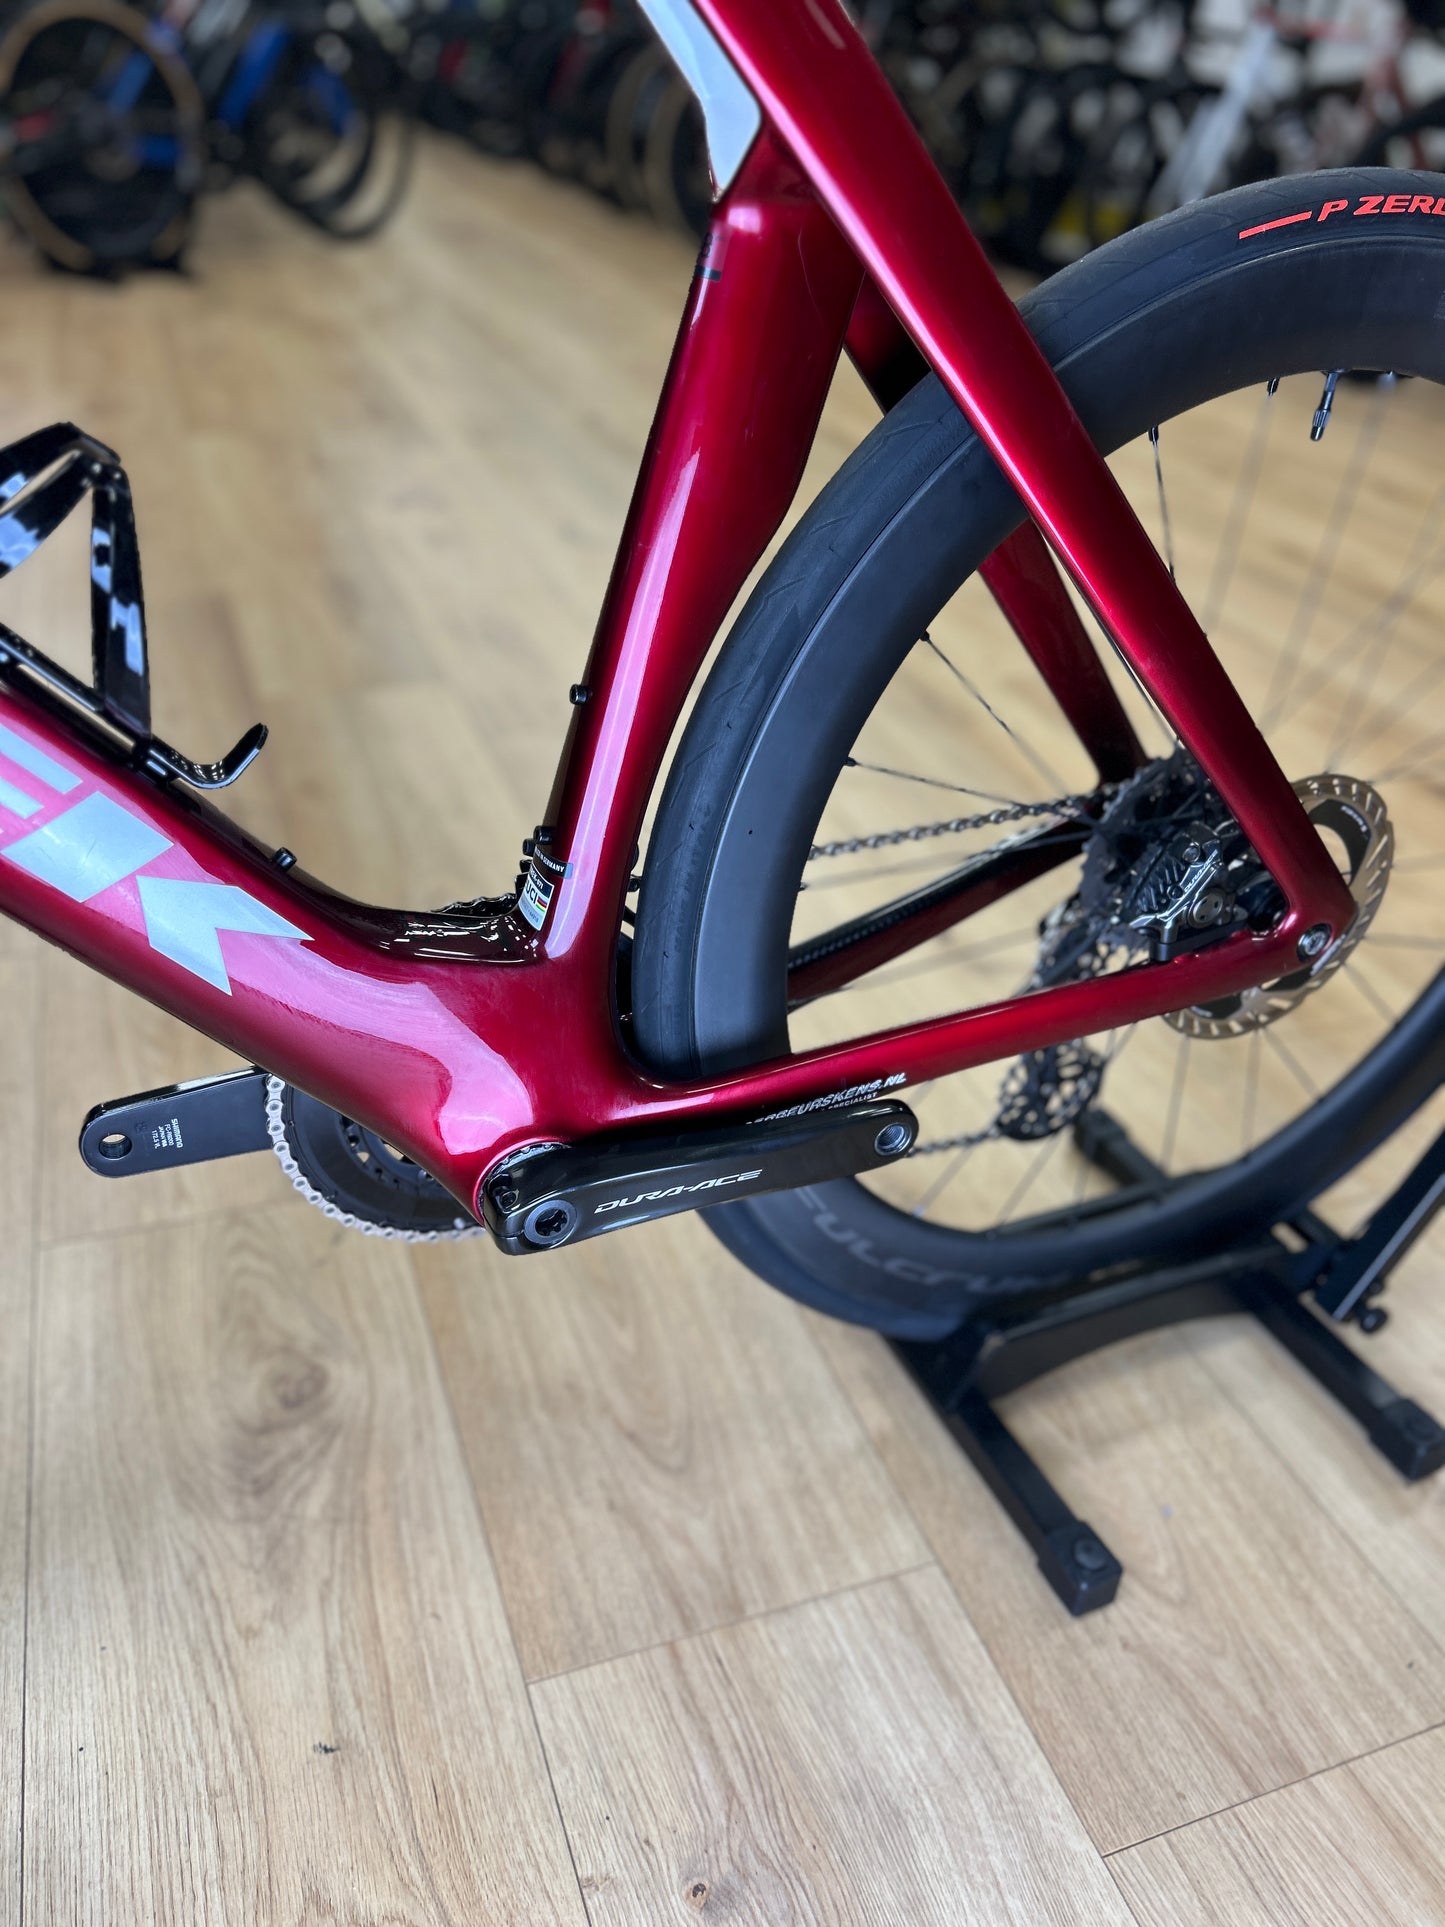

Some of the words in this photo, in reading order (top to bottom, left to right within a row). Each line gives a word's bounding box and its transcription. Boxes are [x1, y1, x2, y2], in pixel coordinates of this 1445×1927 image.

[1317, 200, 1348, 222] P
[171, 1118, 183, 1148] SHIMANO
[594, 1168, 763, 1214] DURA-ACE
